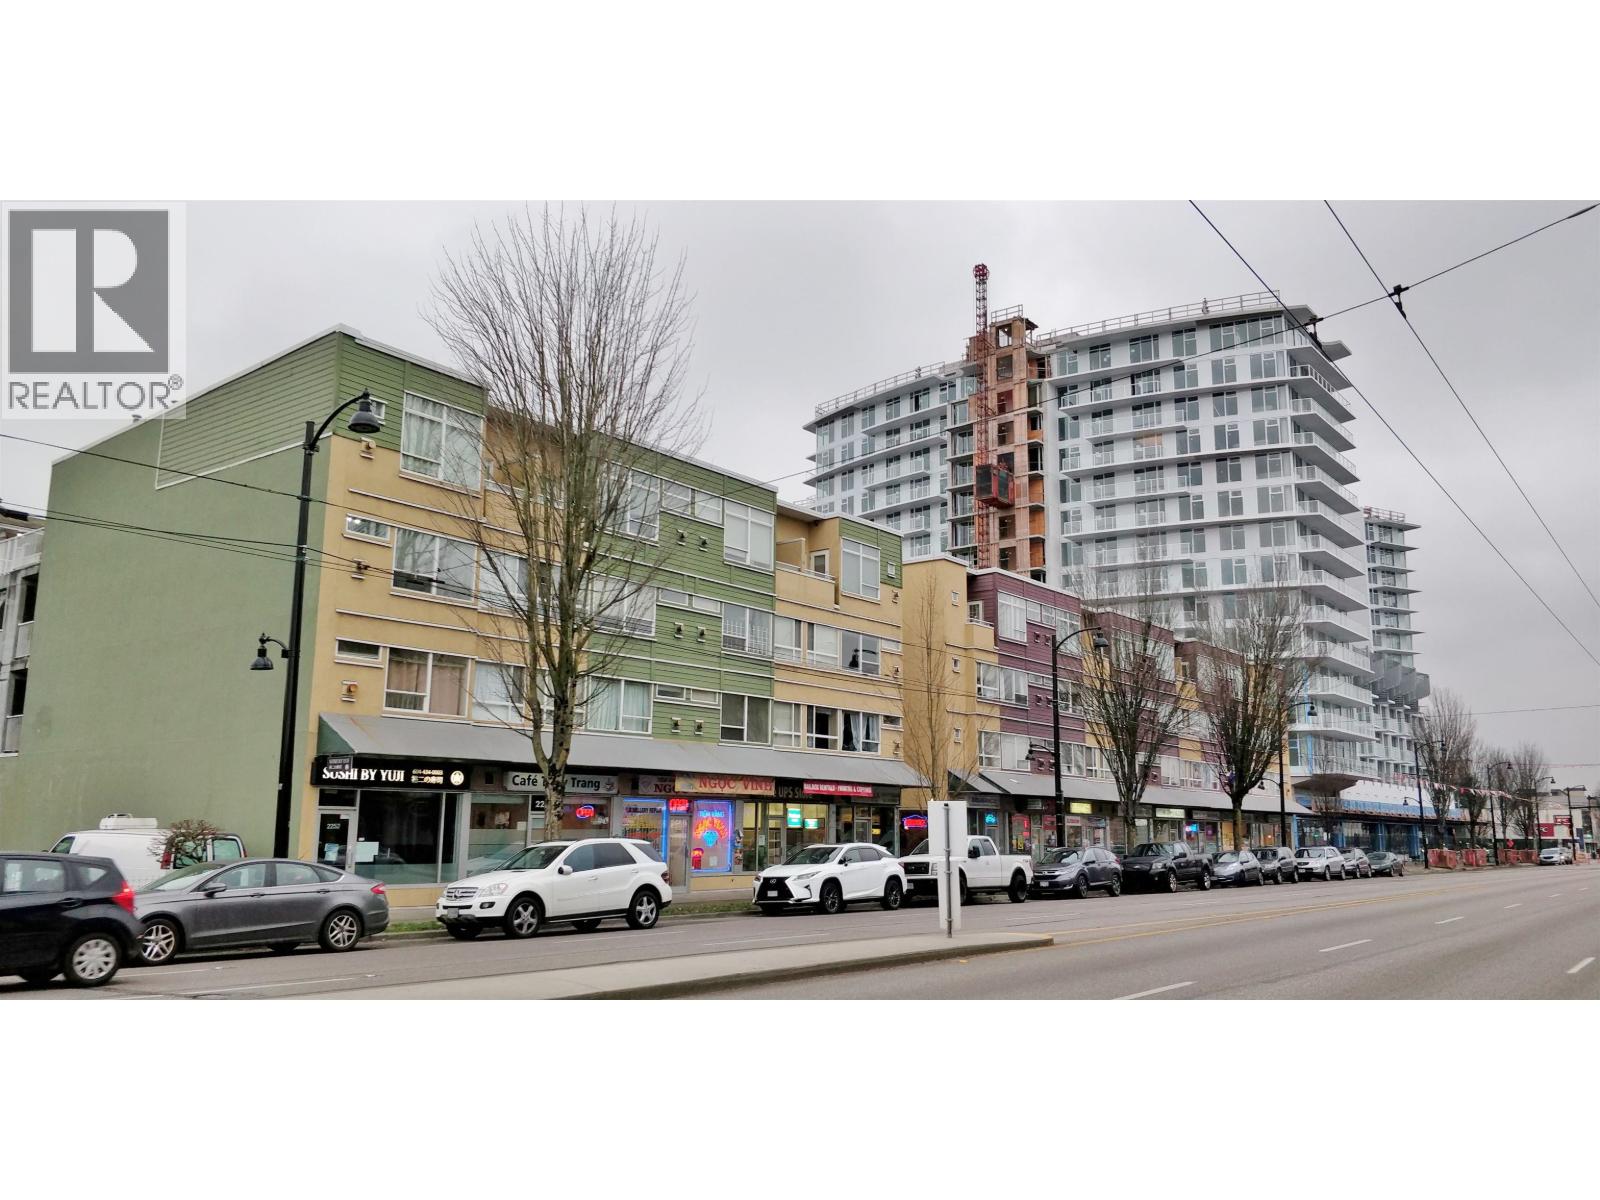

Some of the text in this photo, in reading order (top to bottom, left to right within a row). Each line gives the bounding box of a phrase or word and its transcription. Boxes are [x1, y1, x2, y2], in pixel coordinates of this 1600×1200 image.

[322, 766, 405, 782] SUSHI BY YUJI
[511, 774, 538, 786] Café
[571, 777, 600, 791] Trang
[778, 786, 794, 798] UPS
[535, 800, 545, 808] 22
